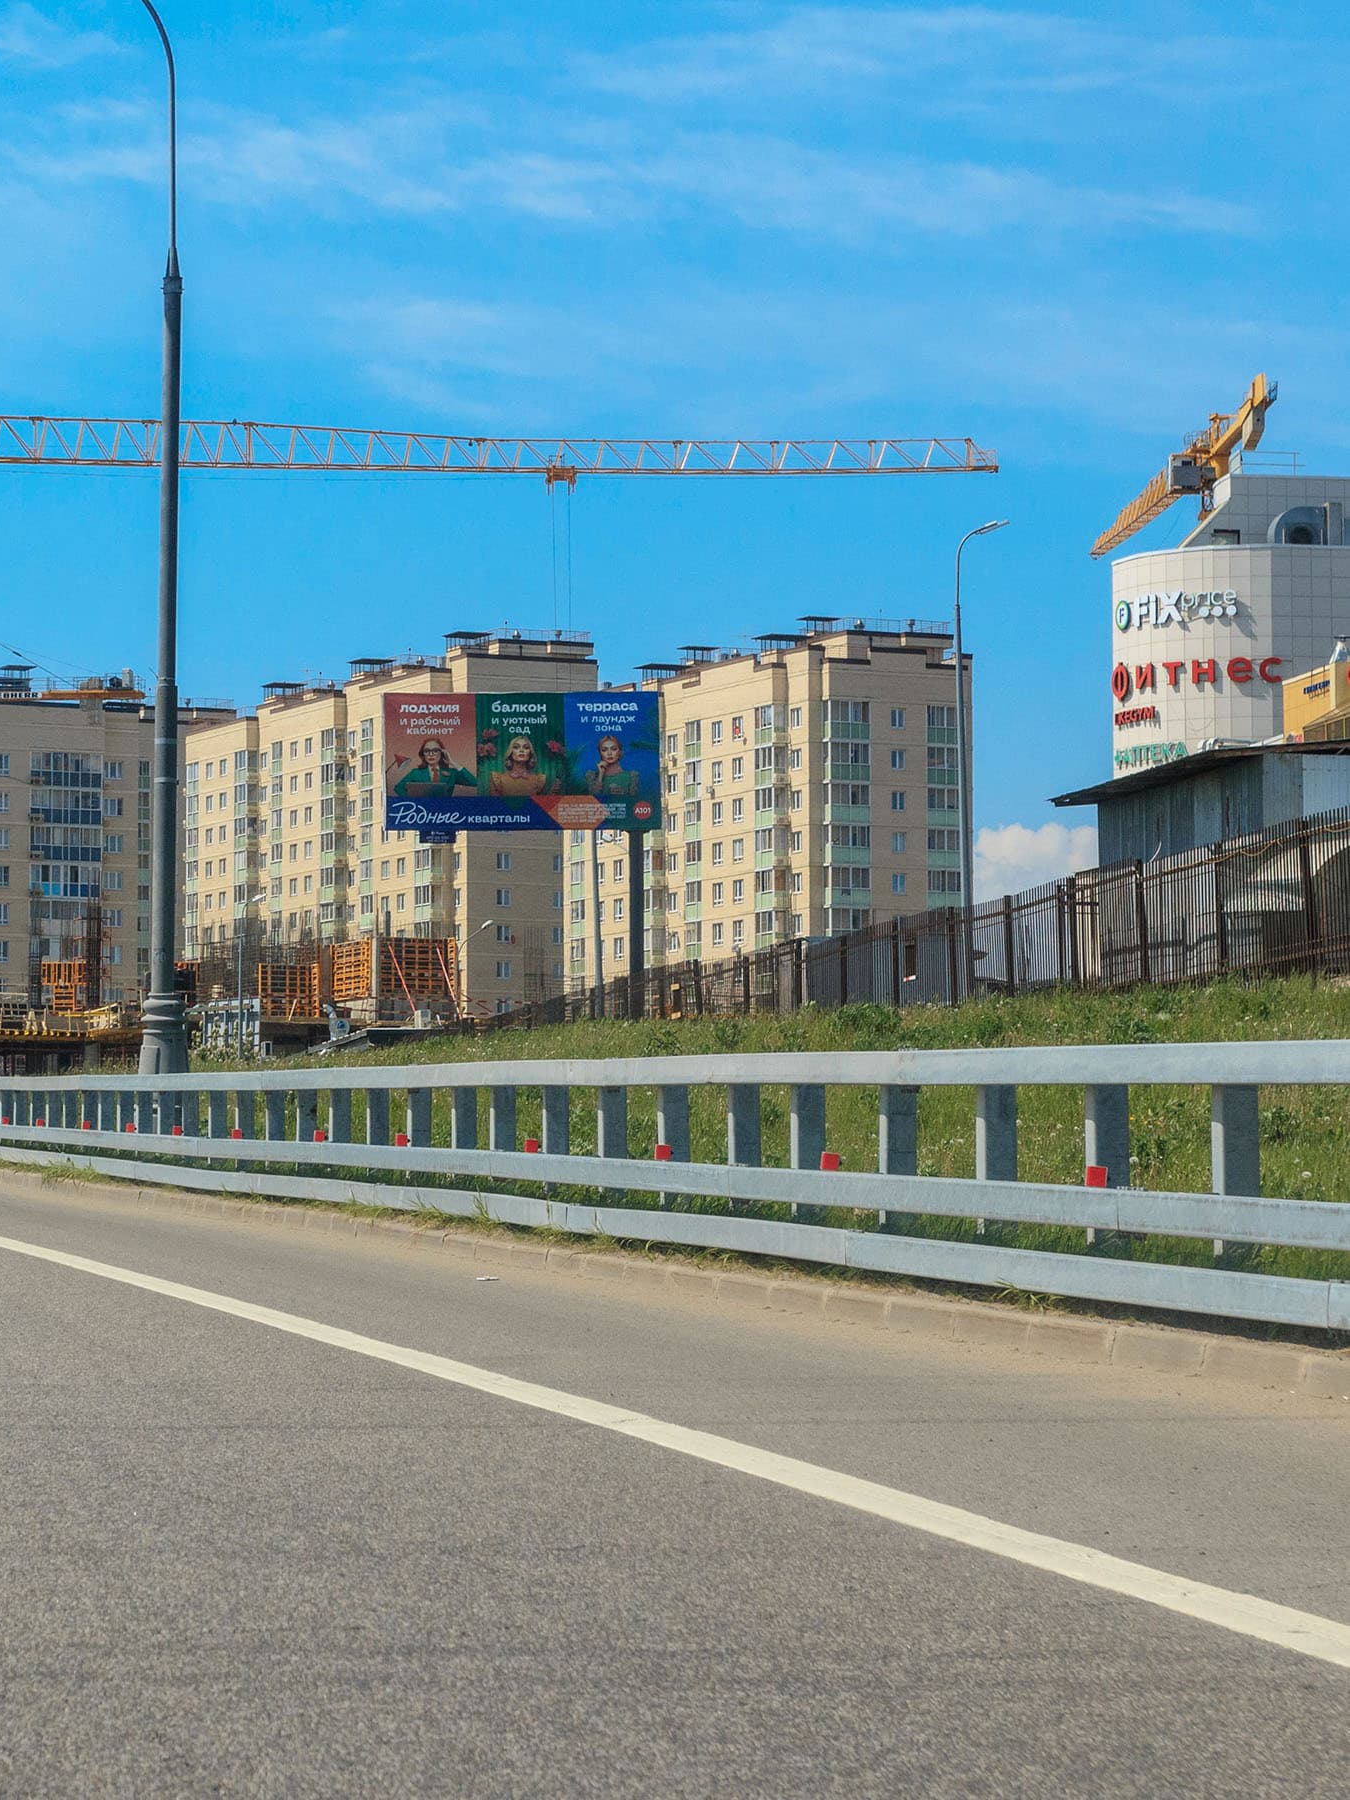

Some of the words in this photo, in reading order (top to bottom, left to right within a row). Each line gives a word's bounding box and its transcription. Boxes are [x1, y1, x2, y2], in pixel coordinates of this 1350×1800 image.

[1134, 590, 1182, 627] FIX
[1180, 589, 1237, 609] price
[399, 704, 460, 714] лоджия
[491, 700, 547, 713] балкон
[576, 702, 639, 713] терраса
[400, 718, 408, 726] и
[410, 716, 461, 727] рабочий
[502, 715, 548, 726] уютный
[591, 715, 637, 725] лаундж
[406, 726, 455, 735] кабинет
[508, 726, 531, 735] сад
[389, 801, 467, 825] Родные
[468, 815, 531, 825] кварталы
